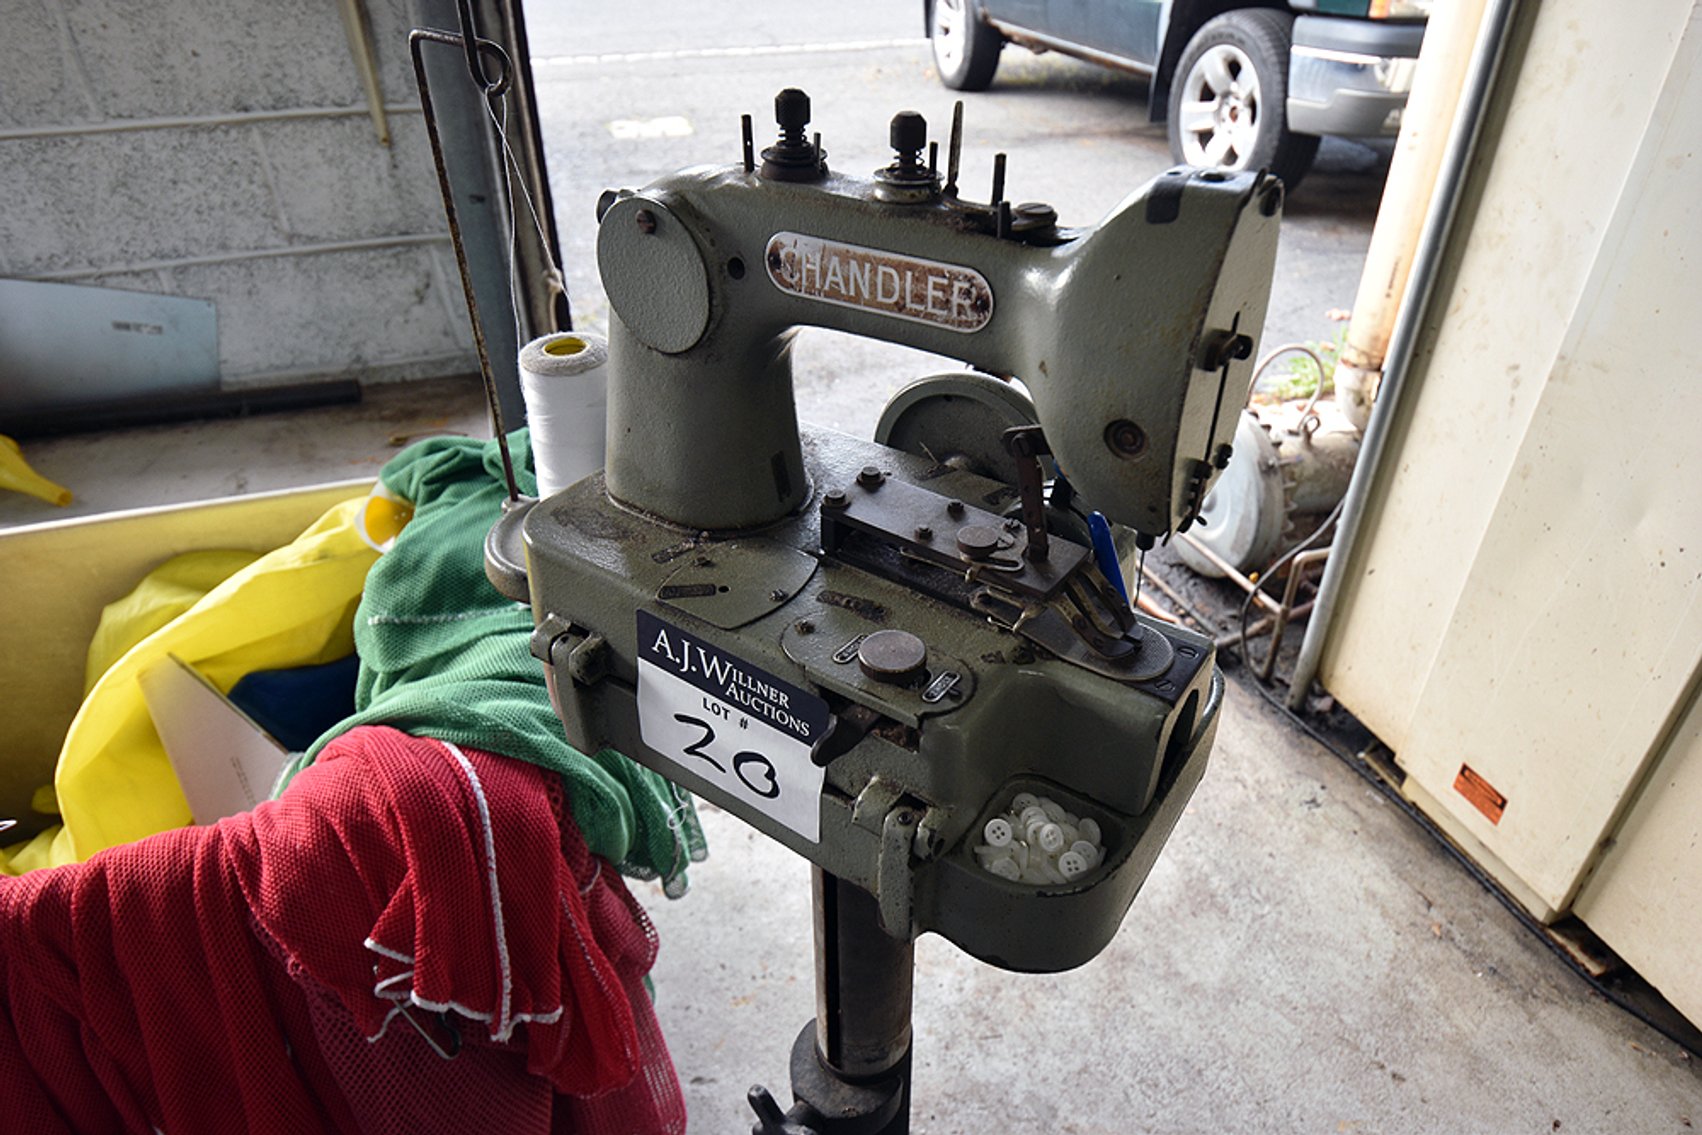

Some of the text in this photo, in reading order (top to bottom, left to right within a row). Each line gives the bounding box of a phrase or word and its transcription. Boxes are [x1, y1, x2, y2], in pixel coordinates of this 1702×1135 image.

[779, 245, 977, 320] CHANDLER
[703, 697, 749, 730] LOT #
[725, 686, 810, 738] AUCTIONS
[673, 712, 780, 800] 20
